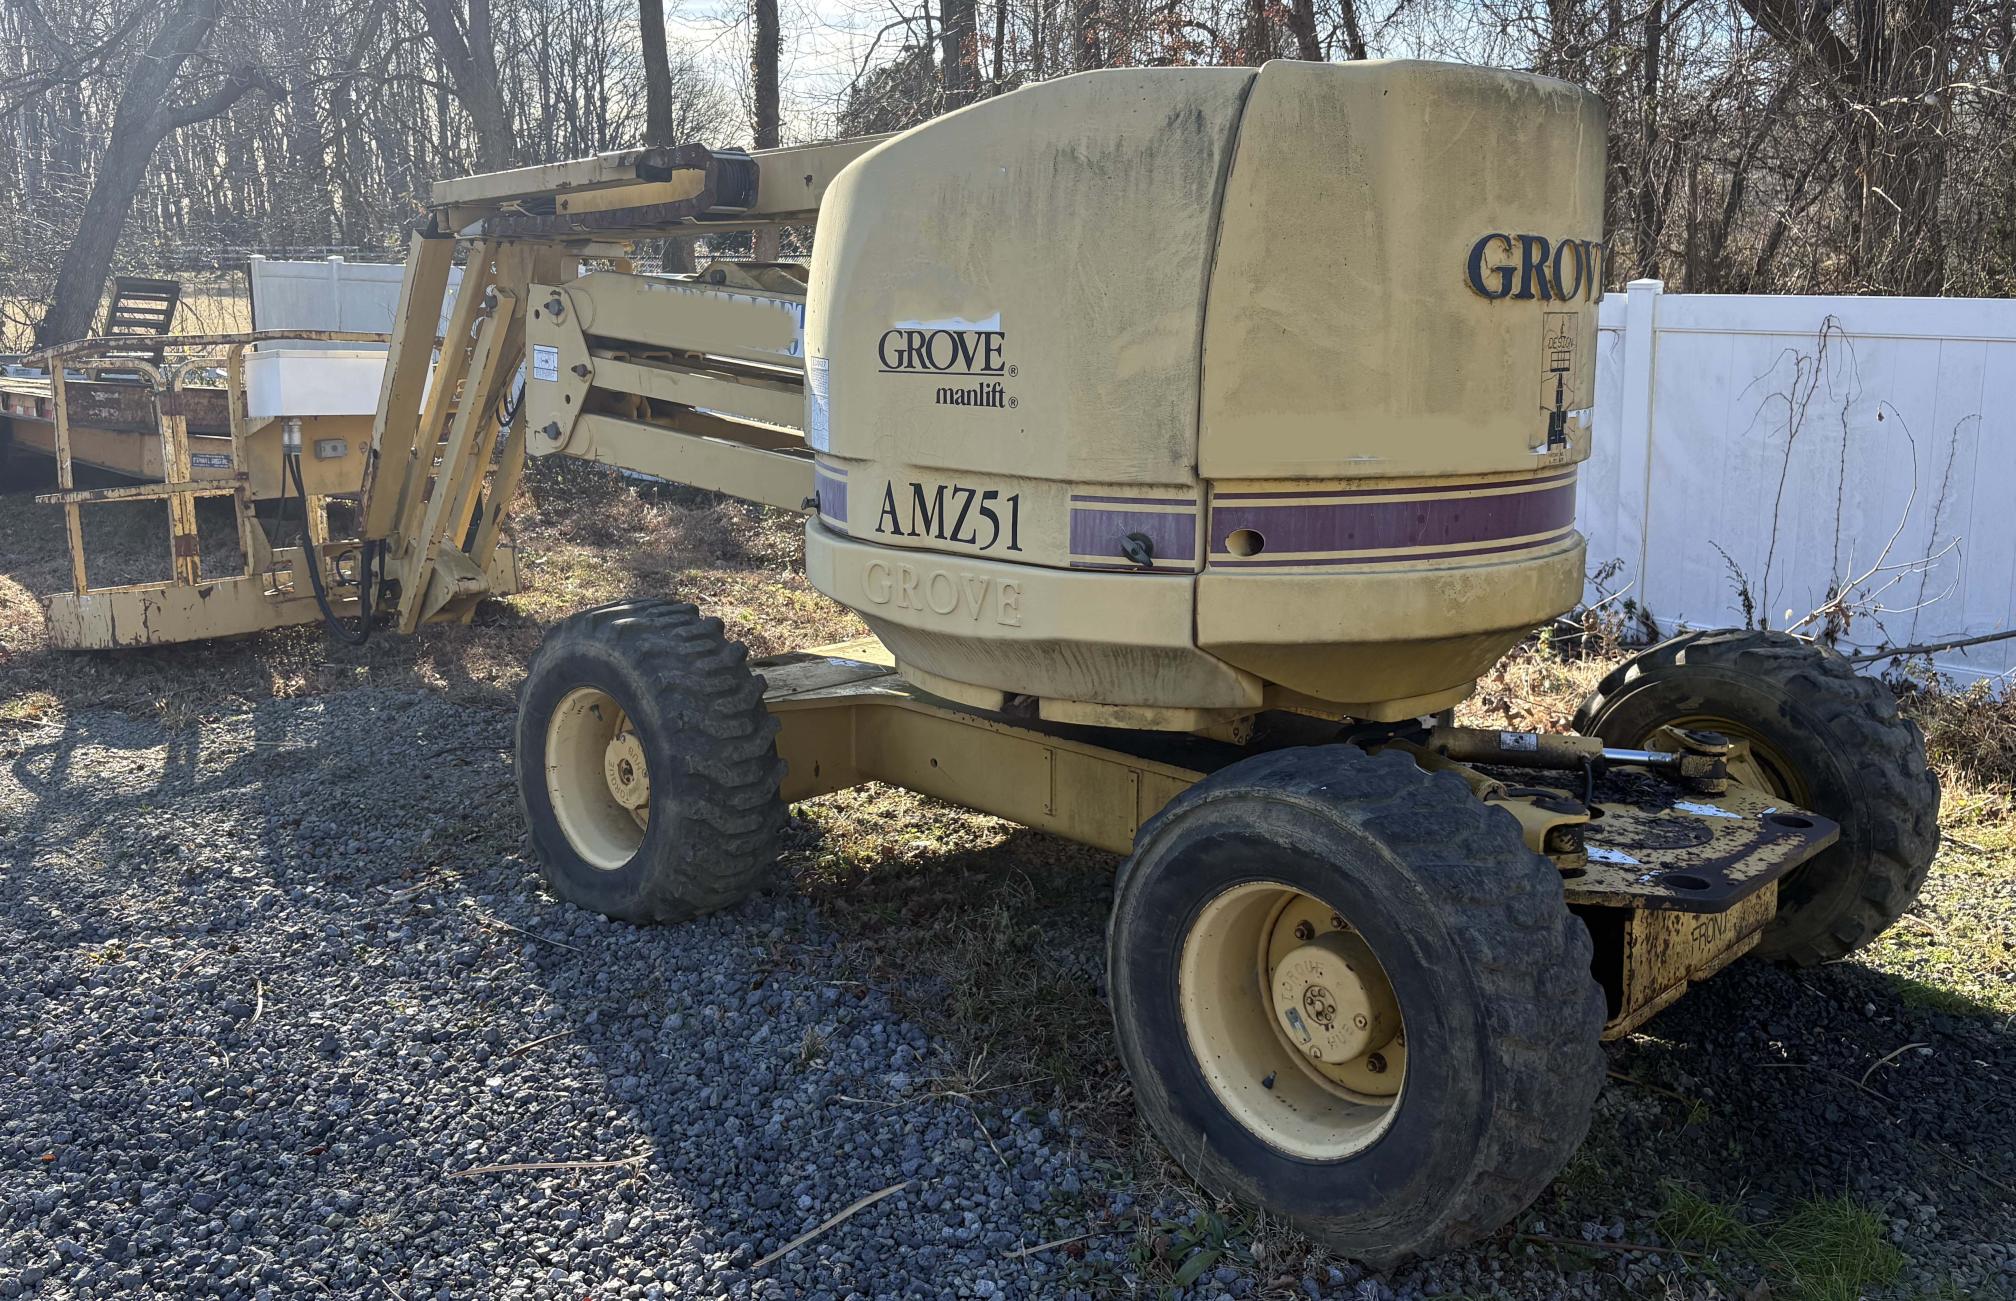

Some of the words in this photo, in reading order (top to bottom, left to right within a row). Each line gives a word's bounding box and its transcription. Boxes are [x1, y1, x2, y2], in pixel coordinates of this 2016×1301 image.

[875, 479, 1023, 552] AMZ51
[863, 560, 1022, 627] GROVE
[628, 746, 642, 771] HUB
[608, 759, 630, 803] TORQUE
[1281, 959, 1326, 1002] TORQUE
